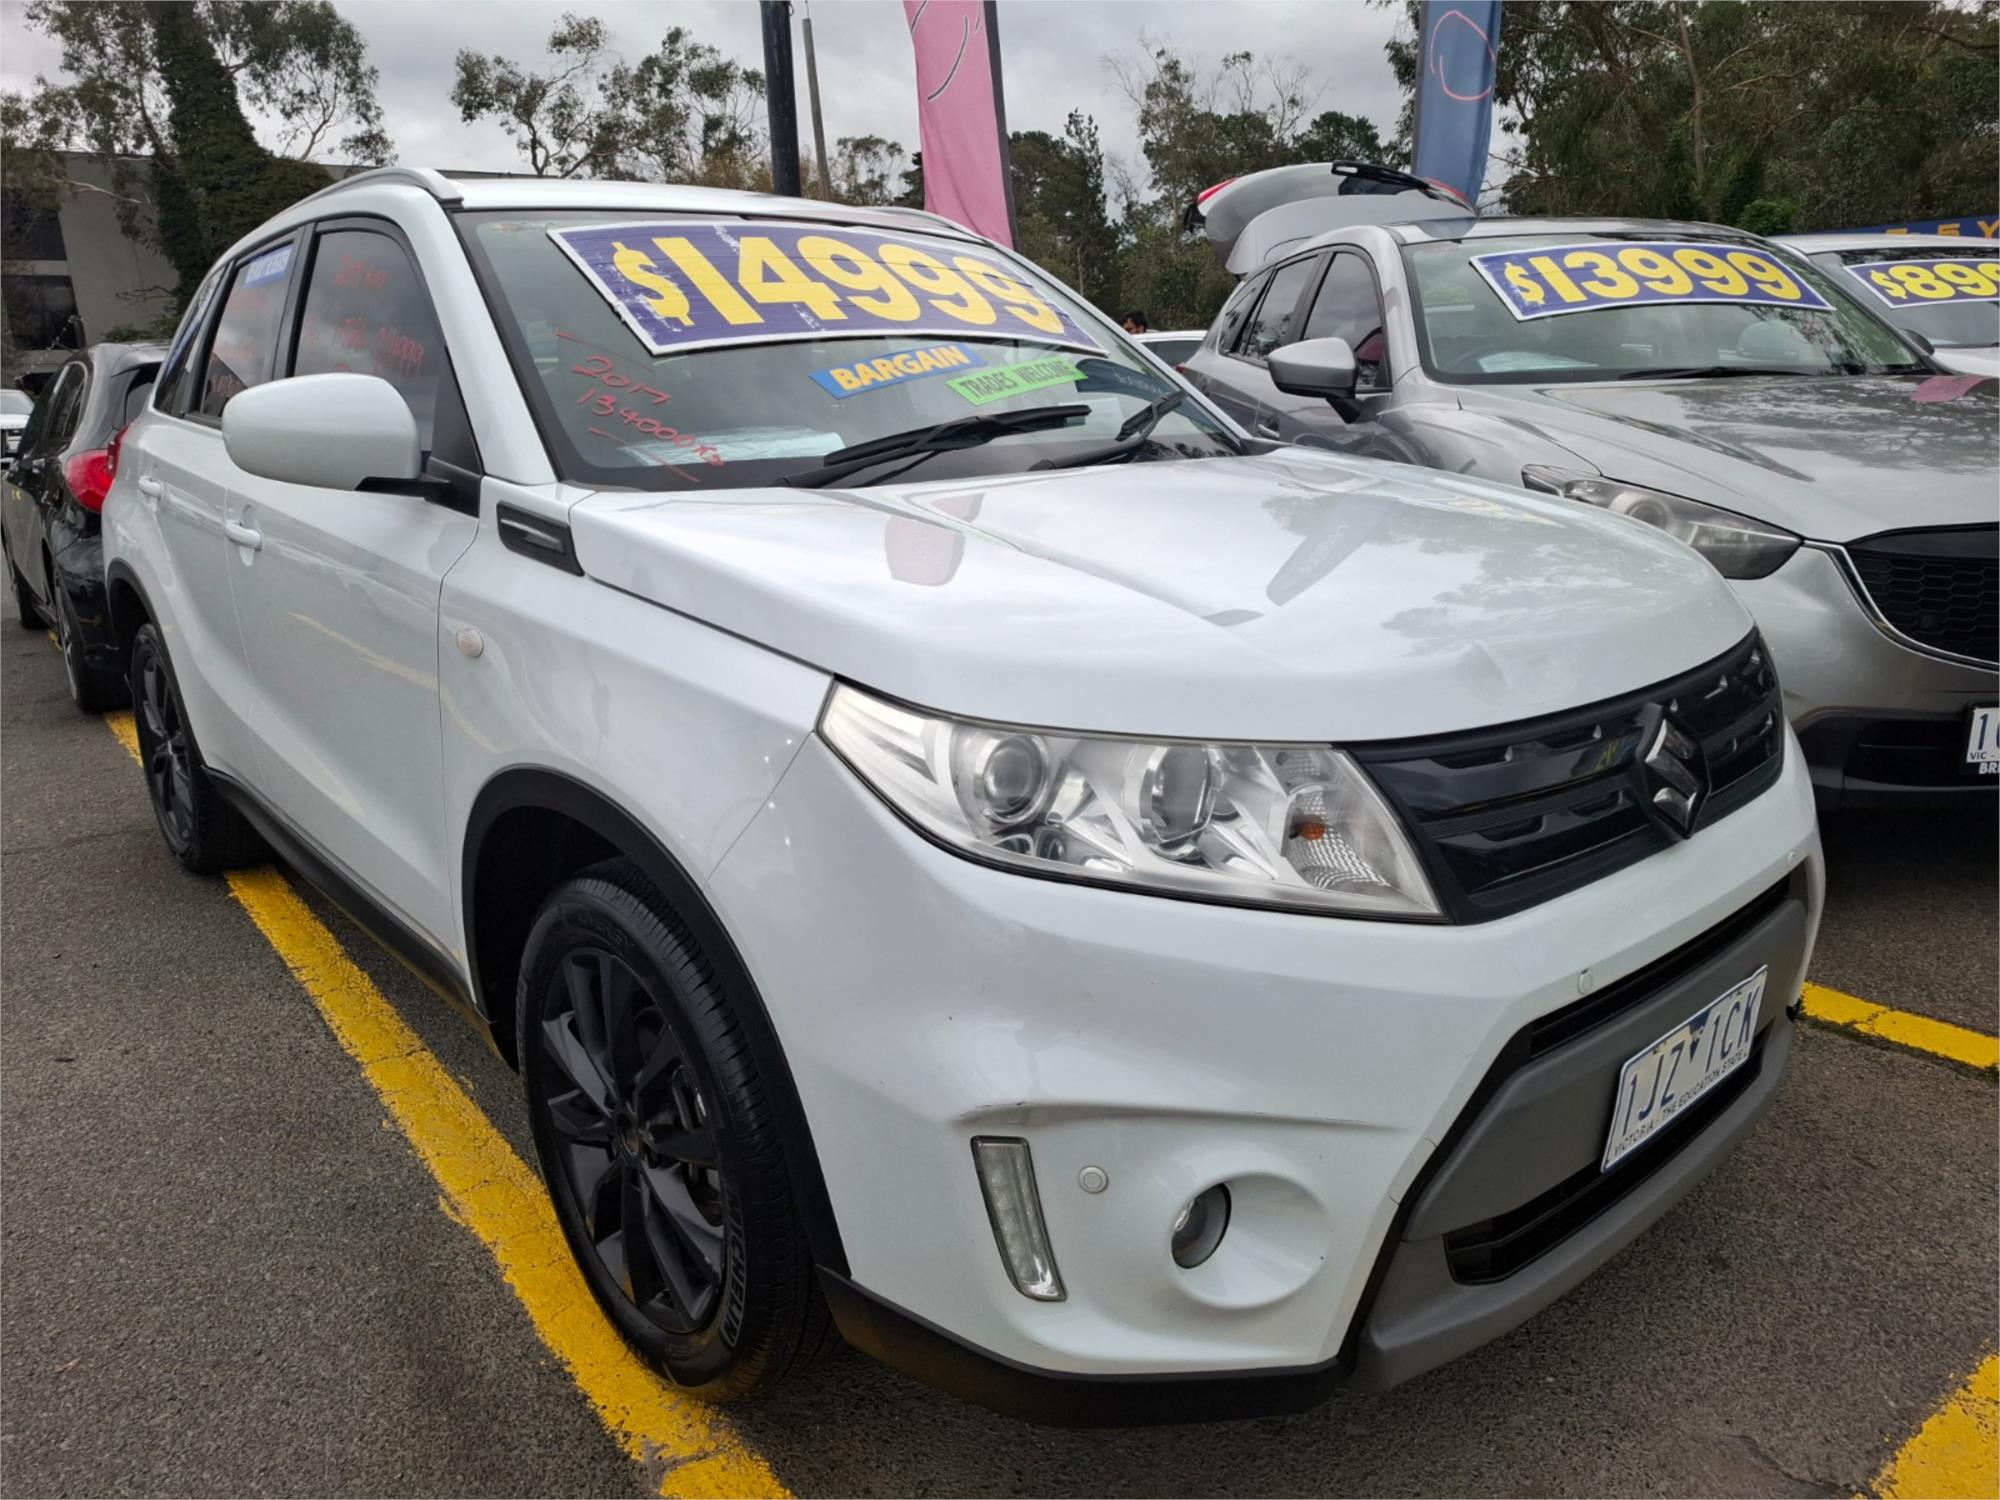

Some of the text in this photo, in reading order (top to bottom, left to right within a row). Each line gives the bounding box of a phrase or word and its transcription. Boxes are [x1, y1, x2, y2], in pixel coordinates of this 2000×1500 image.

[611, 234, 1066, 335] $14999
[1504, 247, 1803, 305] $13999
[570, 354, 673, 406] 2017
[830, 345, 971, 391] BARGAIN
[958, 371, 1019, 399] TRADES
[1970, 751, 1988, 761] VIC
[1978, 713, 1999, 750] 1
[1615, 1048, 1744, 1156] VICTORIA THE EDUCATION STATE
[719, 1190, 748, 1349] MICHELIN
